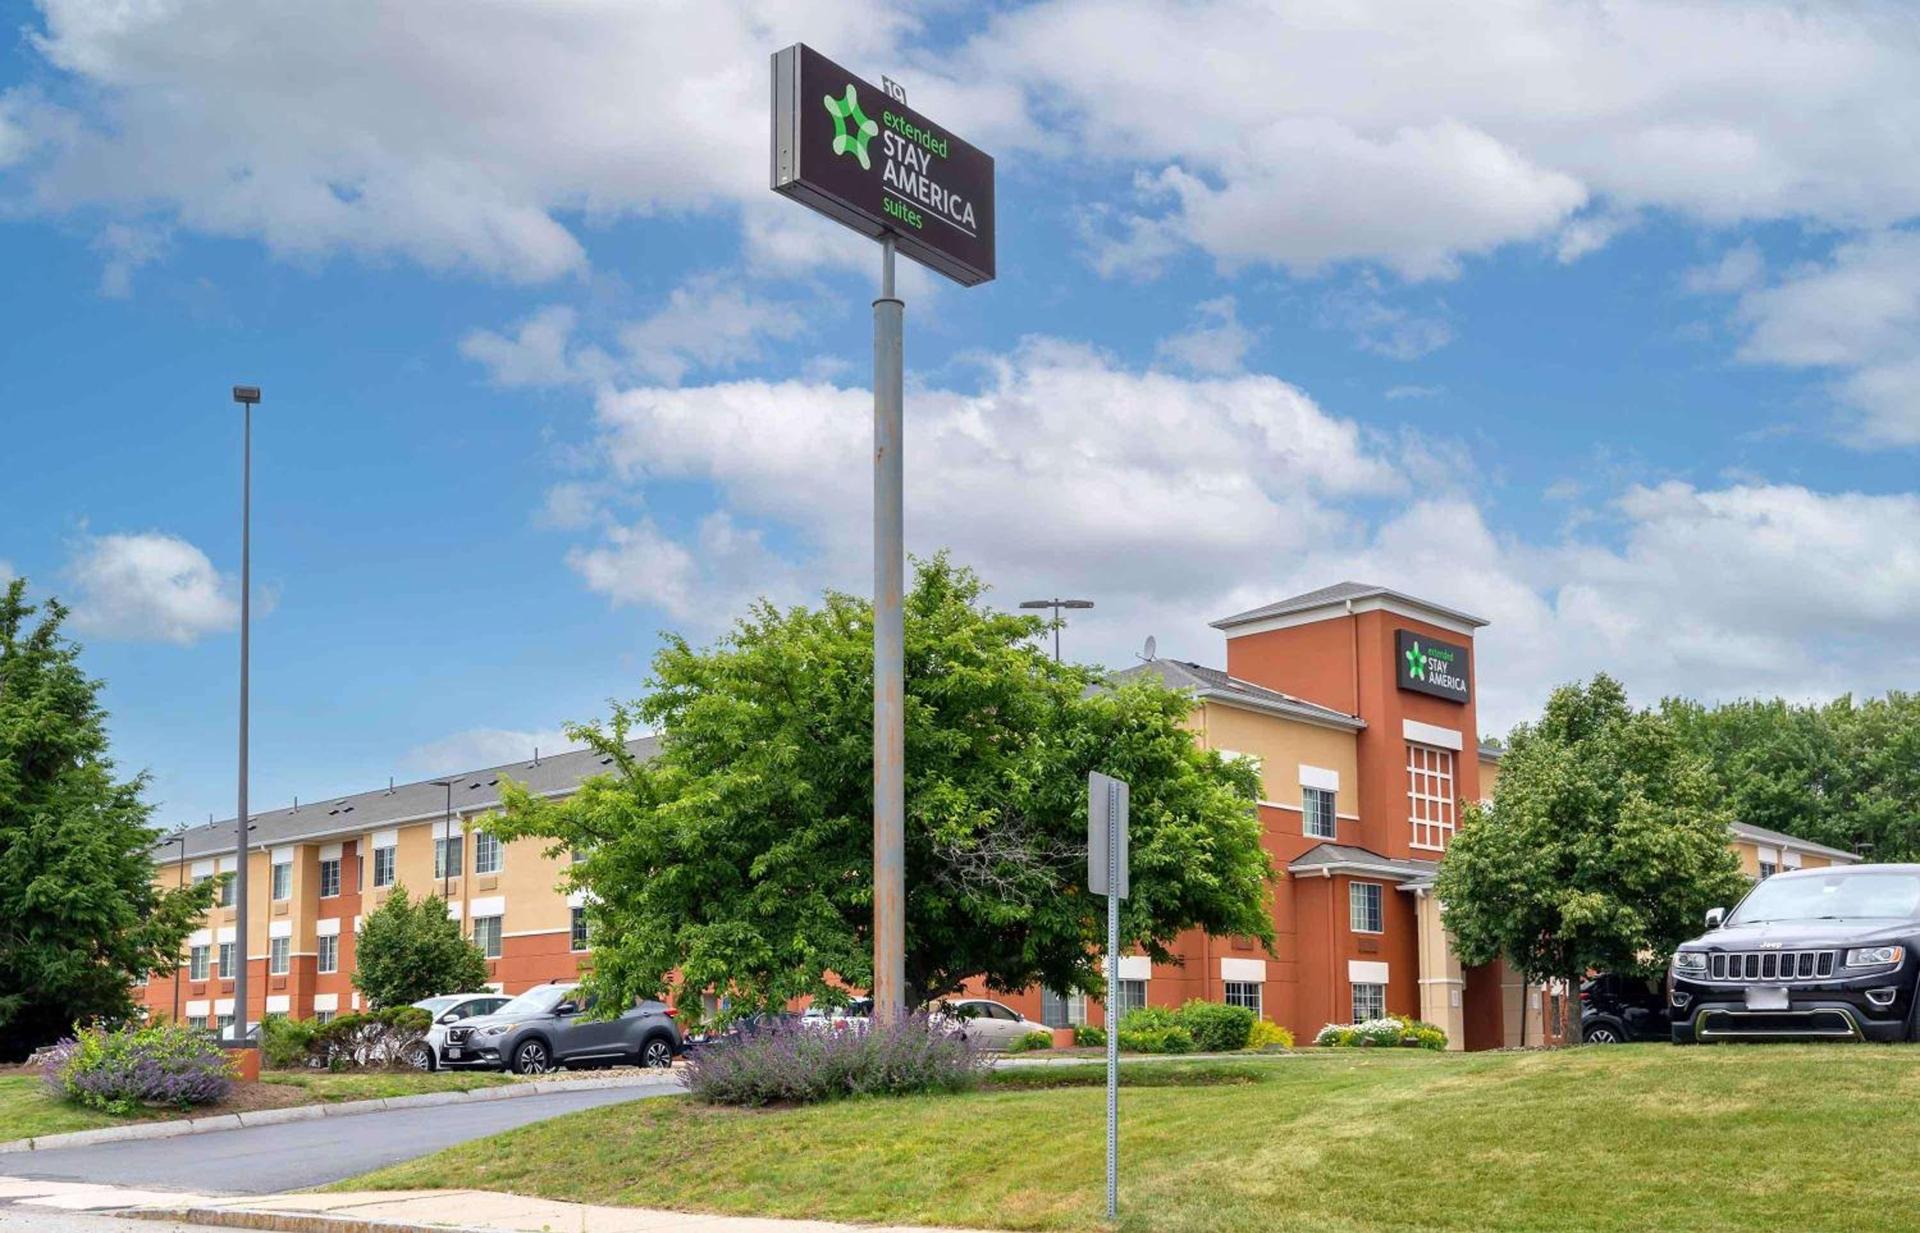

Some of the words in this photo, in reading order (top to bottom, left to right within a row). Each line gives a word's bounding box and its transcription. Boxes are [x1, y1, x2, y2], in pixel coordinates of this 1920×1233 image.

[883, 110, 947, 159] extended
[883, 130, 931, 175] STAY
[883, 159, 976, 229] AMERICA
[883, 196, 923, 230] suites
[1428, 648, 1454, 661] extended
[1428, 657, 1448, 673] STAY
[1429, 672, 1466, 692] AMERICA
